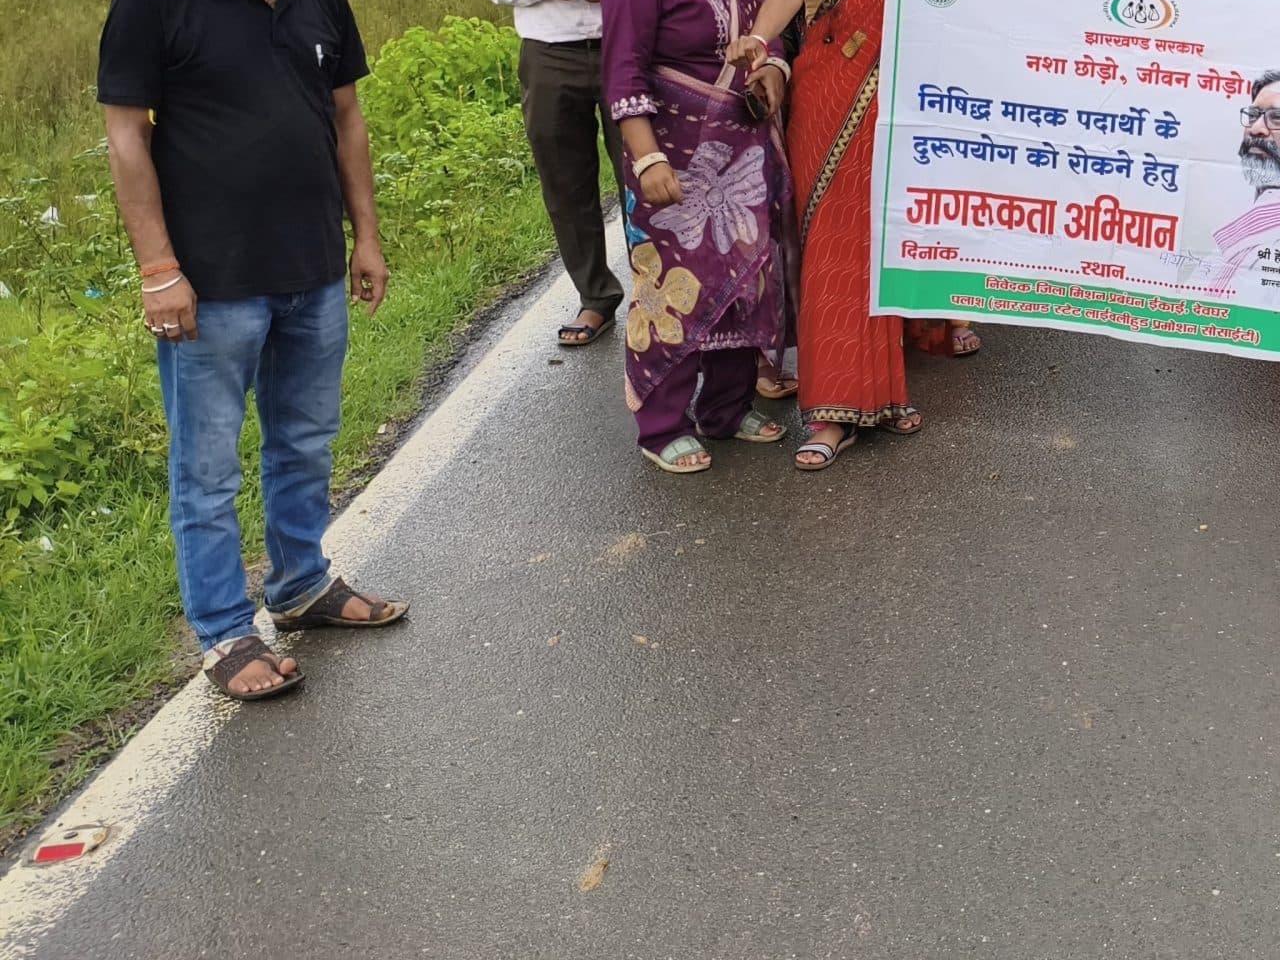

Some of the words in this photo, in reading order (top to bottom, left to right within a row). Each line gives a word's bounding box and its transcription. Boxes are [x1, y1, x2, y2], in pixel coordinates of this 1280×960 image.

[1085, 31, 1150, 50] झारखण्ड
[1155, 39, 1205, 58] सरकार
[1026, 55, 1067, 74] नशा
[1074, 54, 1128, 85] छोड़ो,
[1136, 62, 1190, 88] जीवन
[918, 84, 993, 121] निषिद्ध
[1001, 101, 1068, 127] मादक
[1155, 111, 1180, 139] के
[913, 133, 1018, 165] दुरूपयोग
[1026, 142, 1059, 169] को
[1068, 145, 1133, 178] रोकने
[1143, 152, 1179, 193] हेतु
[906, 187, 1057, 235] जागरूकता
[1063, 195, 1179, 251] अभियान
[1257, 248, 1271, 260] श्री
[951, 295, 984, 308] पलाश
[1054, 303, 1081, 317] स्टेट
[1152, 319, 1197, 335] प्रमोशन
[1069, 286, 1105, 301] मिशन
[1193, 302, 1229, 318] देवघर
